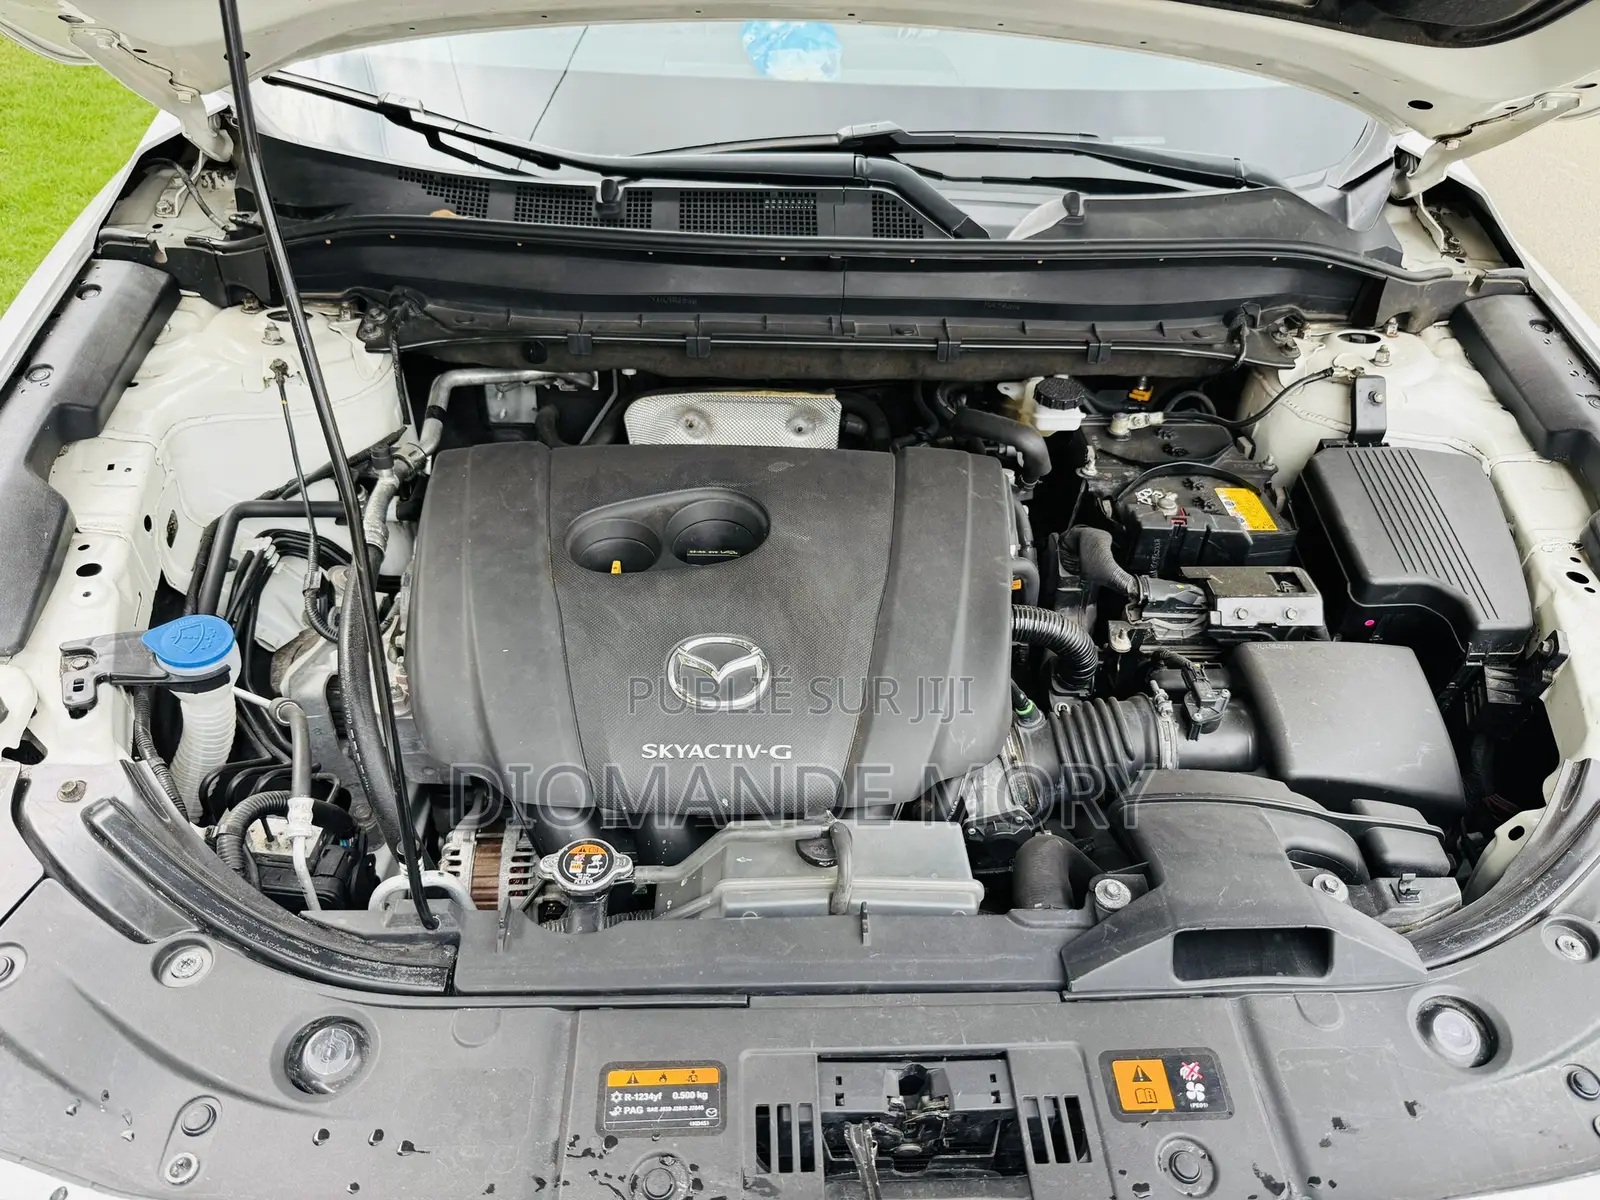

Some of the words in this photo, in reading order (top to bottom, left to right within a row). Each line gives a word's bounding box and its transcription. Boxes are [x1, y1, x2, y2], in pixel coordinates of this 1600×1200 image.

[641, 743, 792, 760] SKYACTIV-G
[624, 1092, 662, 1102] R-1234yf
[672, 1090, 696, 1100] 0.500
[697, 1091, 708, 1101] kg
[623, 1106, 644, 1115] PAG
